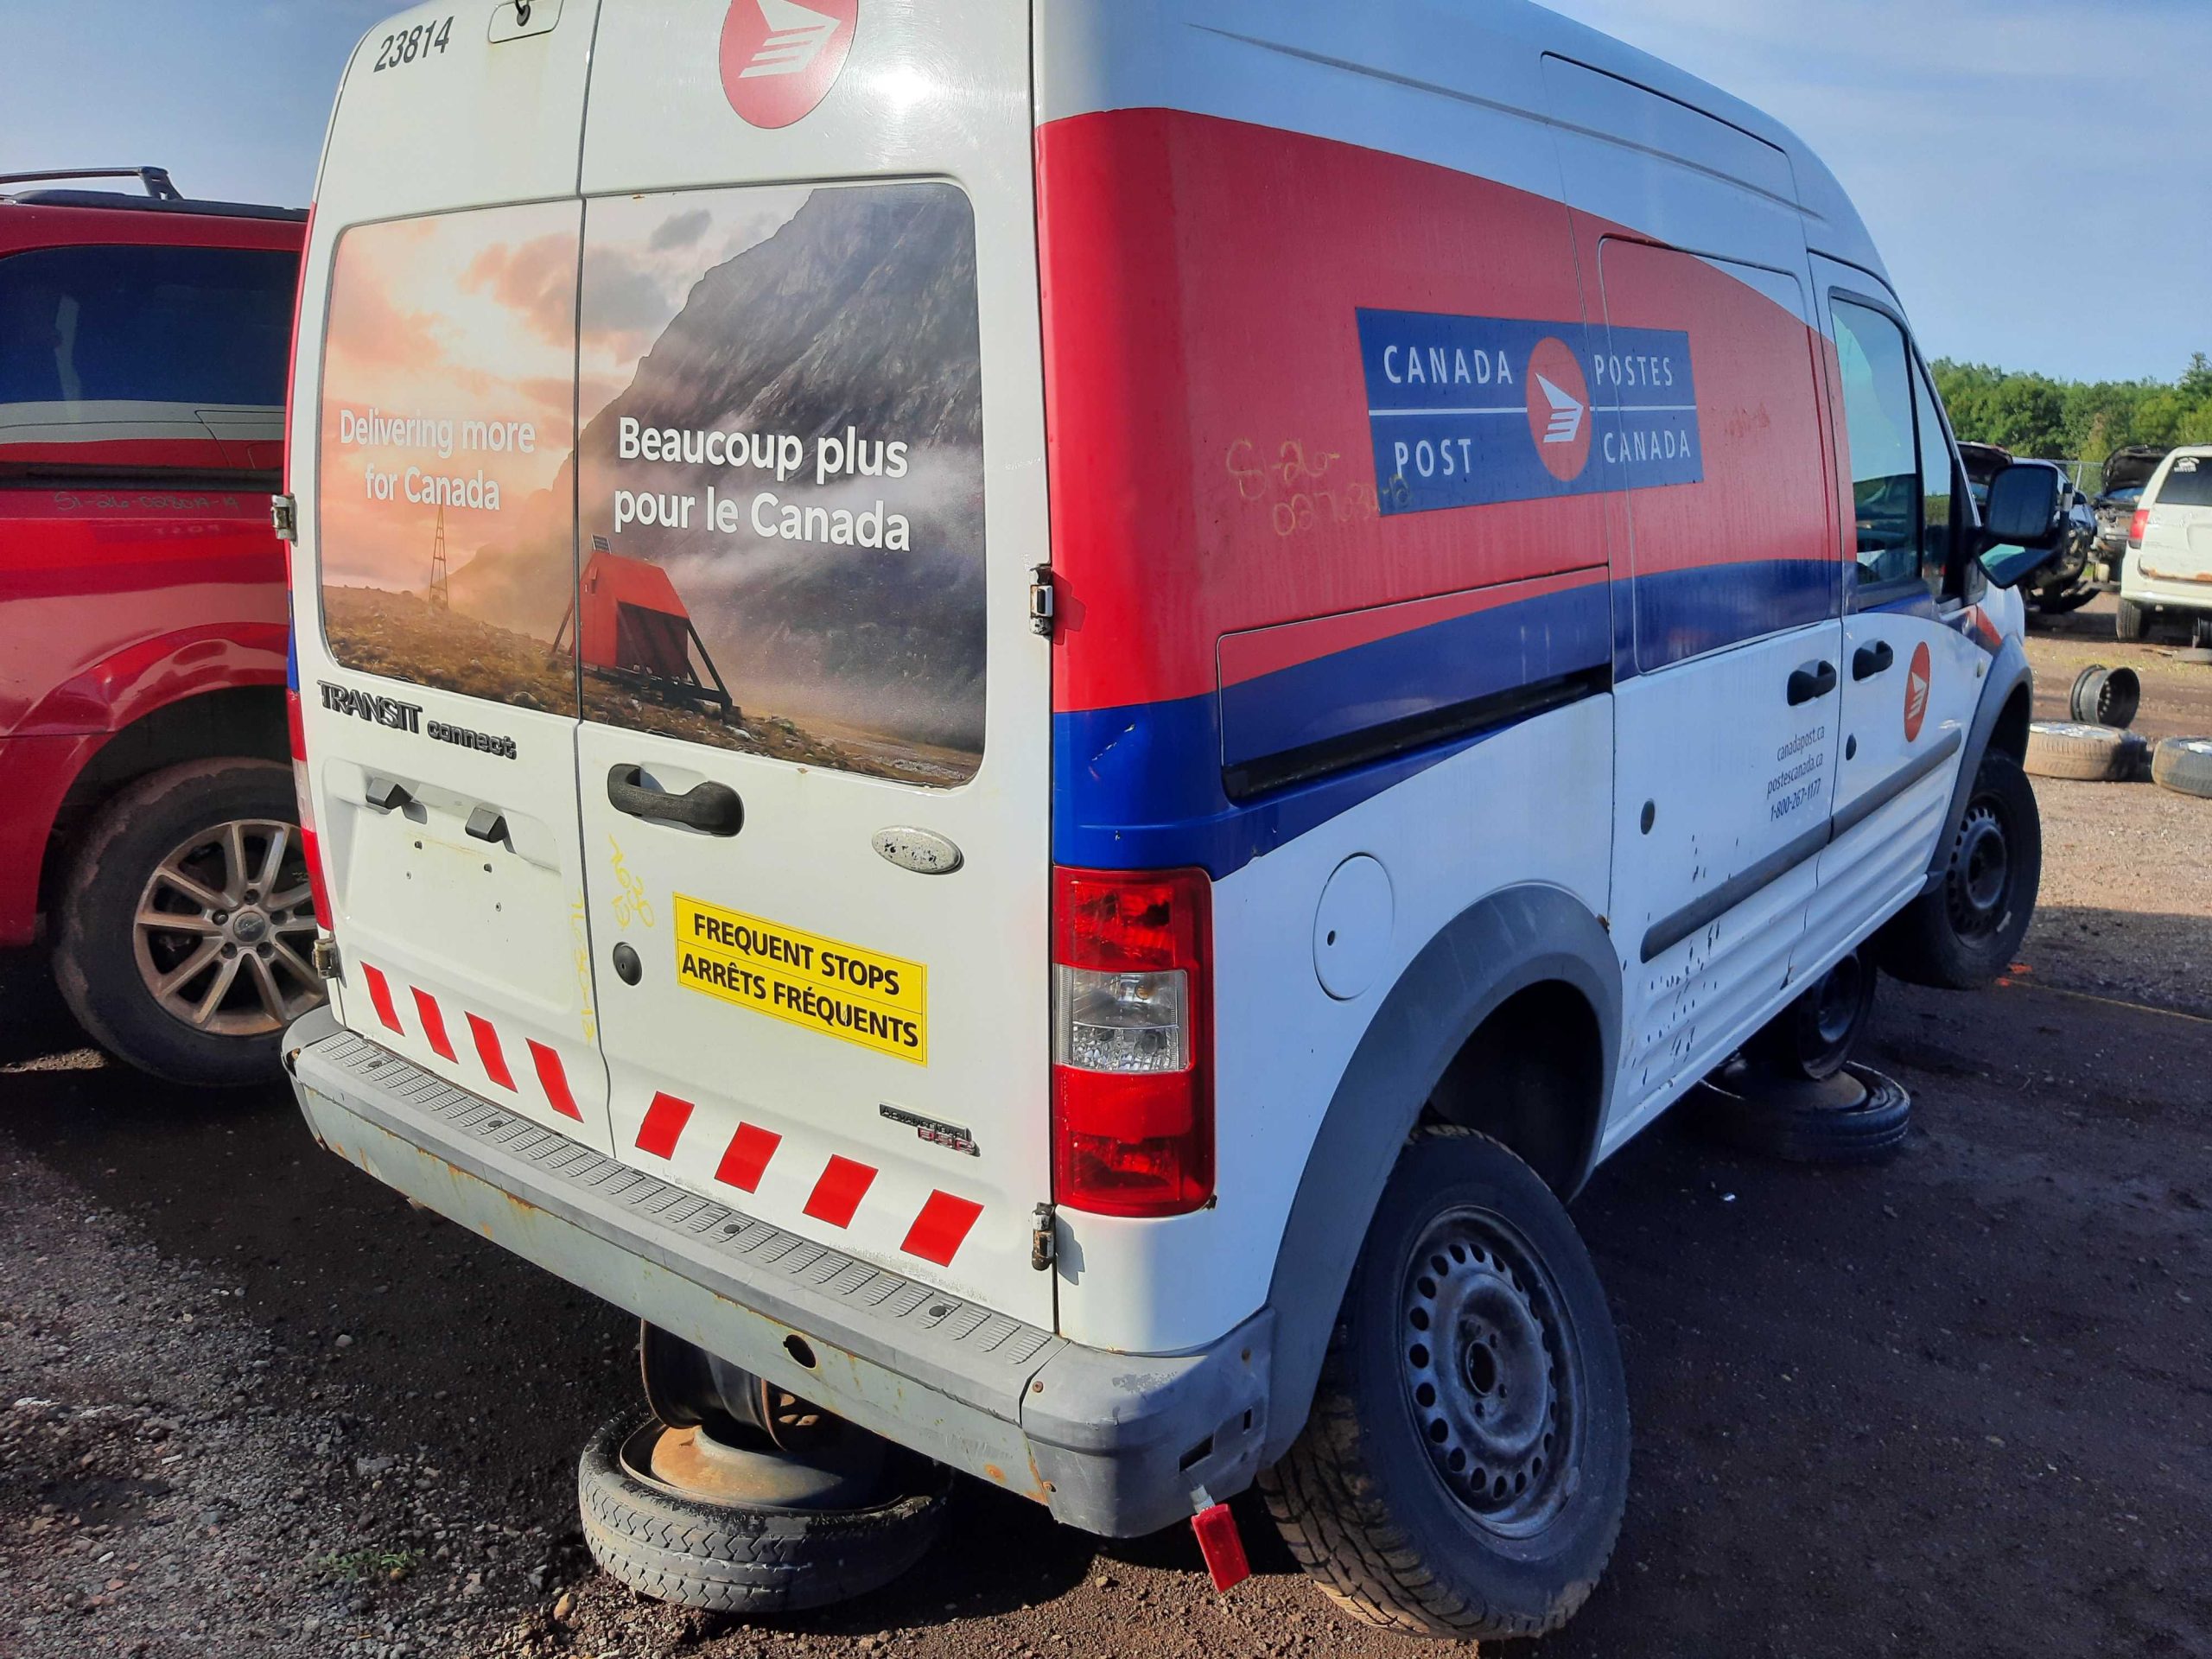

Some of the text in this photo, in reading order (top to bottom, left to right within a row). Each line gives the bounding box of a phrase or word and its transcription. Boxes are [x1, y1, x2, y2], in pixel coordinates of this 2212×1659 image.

[373, 16, 454, 73] 23814
[1383, 345, 1514, 385] CANADA
[1593, 353, 1674, 387] POSTES
[340, 409, 536, 459] Delivering more
[619, 416, 909, 485] Beaucoup plus
[1393, 437, 1473, 479] POST
[1603, 429, 1691, 464] CANADA
[365, 462, 500, 512] for Canada
[613, 486, 911, 552] pour le Canada
[316, 679, 518, 760] TRANSIT connect
[1777, 726, 1825, 762] canadapost.ca
[1766, 753, 1823, 800] postescanada.ca
[1770, 778, 1821, 822] 1-800-267-1177
[694, 912, 900, 996] FREQUENT STOPS
[681, 952, 919, 1048] ARRÊTS FRÉQUENTS
